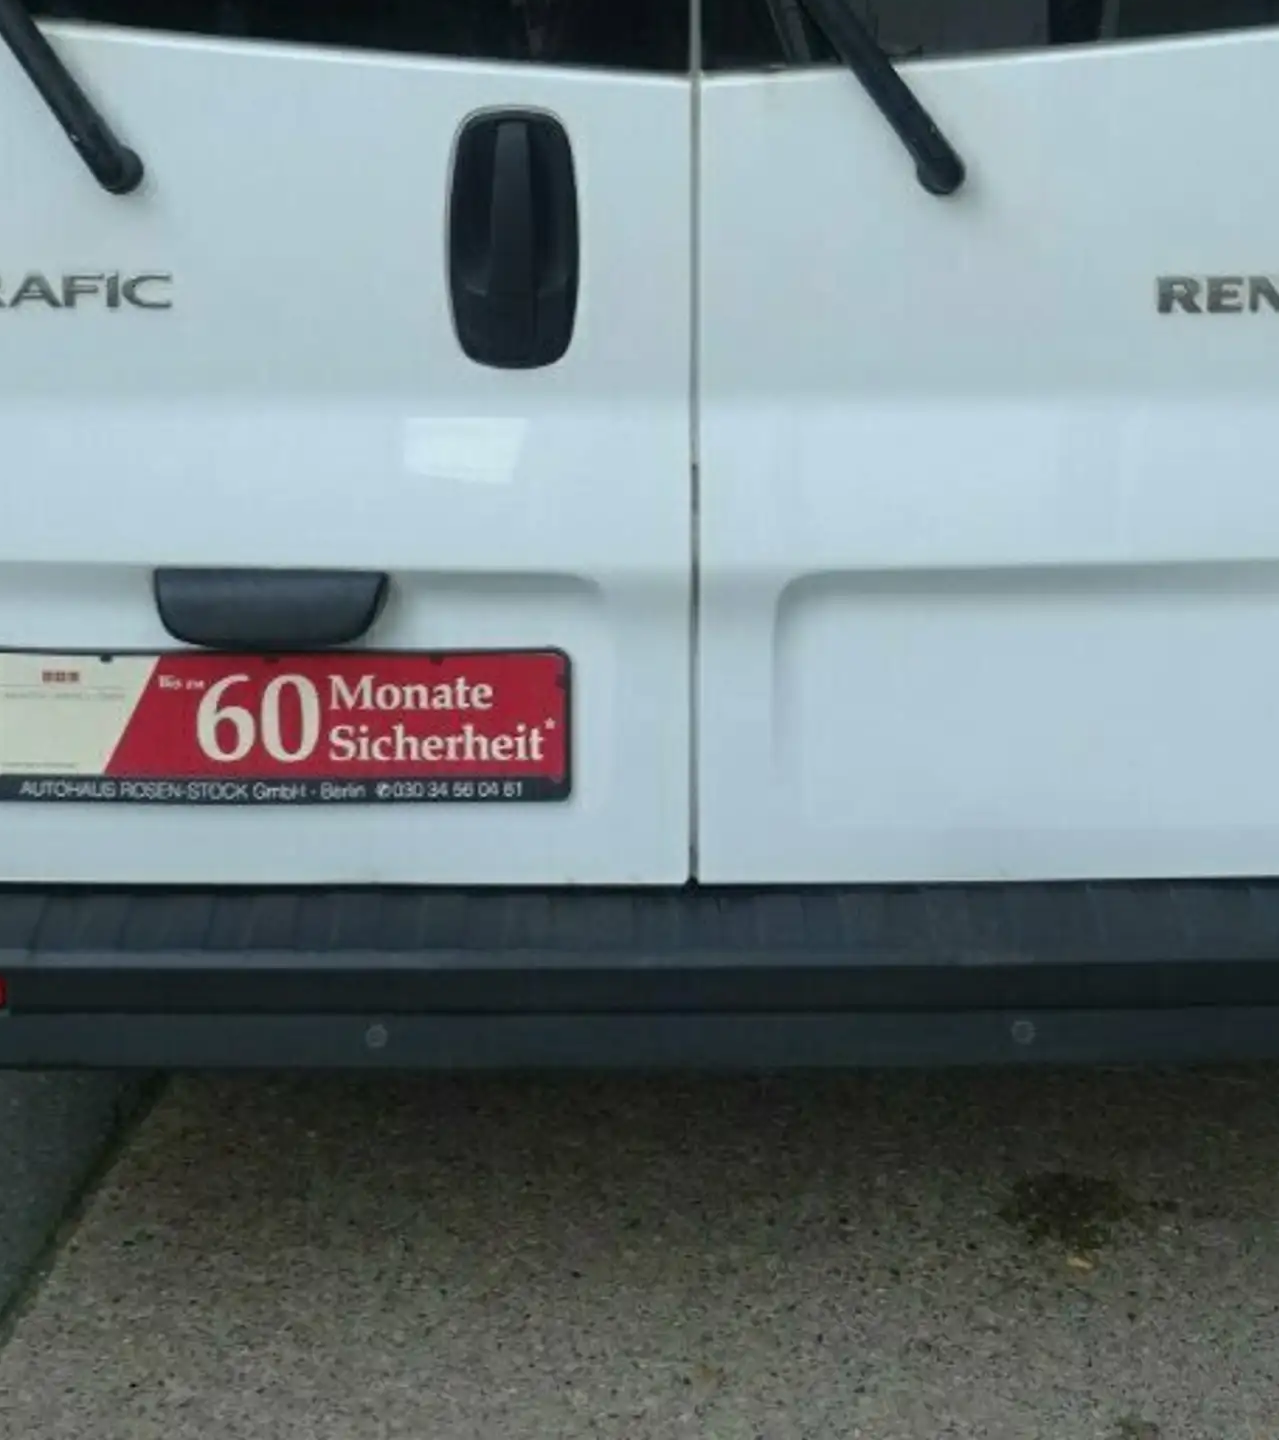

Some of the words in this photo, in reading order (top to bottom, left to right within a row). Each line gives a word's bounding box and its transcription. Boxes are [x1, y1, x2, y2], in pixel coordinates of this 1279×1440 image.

[328, 674, 494, 711] Monate
[196, 673, 320, 762] 60
[19, 780, 116, 799] AUTOHAUS
[120, 780, 249, 800] ROSEN-STOCK
[253, 781, 307, 801] GmbH
[320, 781, 366, 800] Berlin
